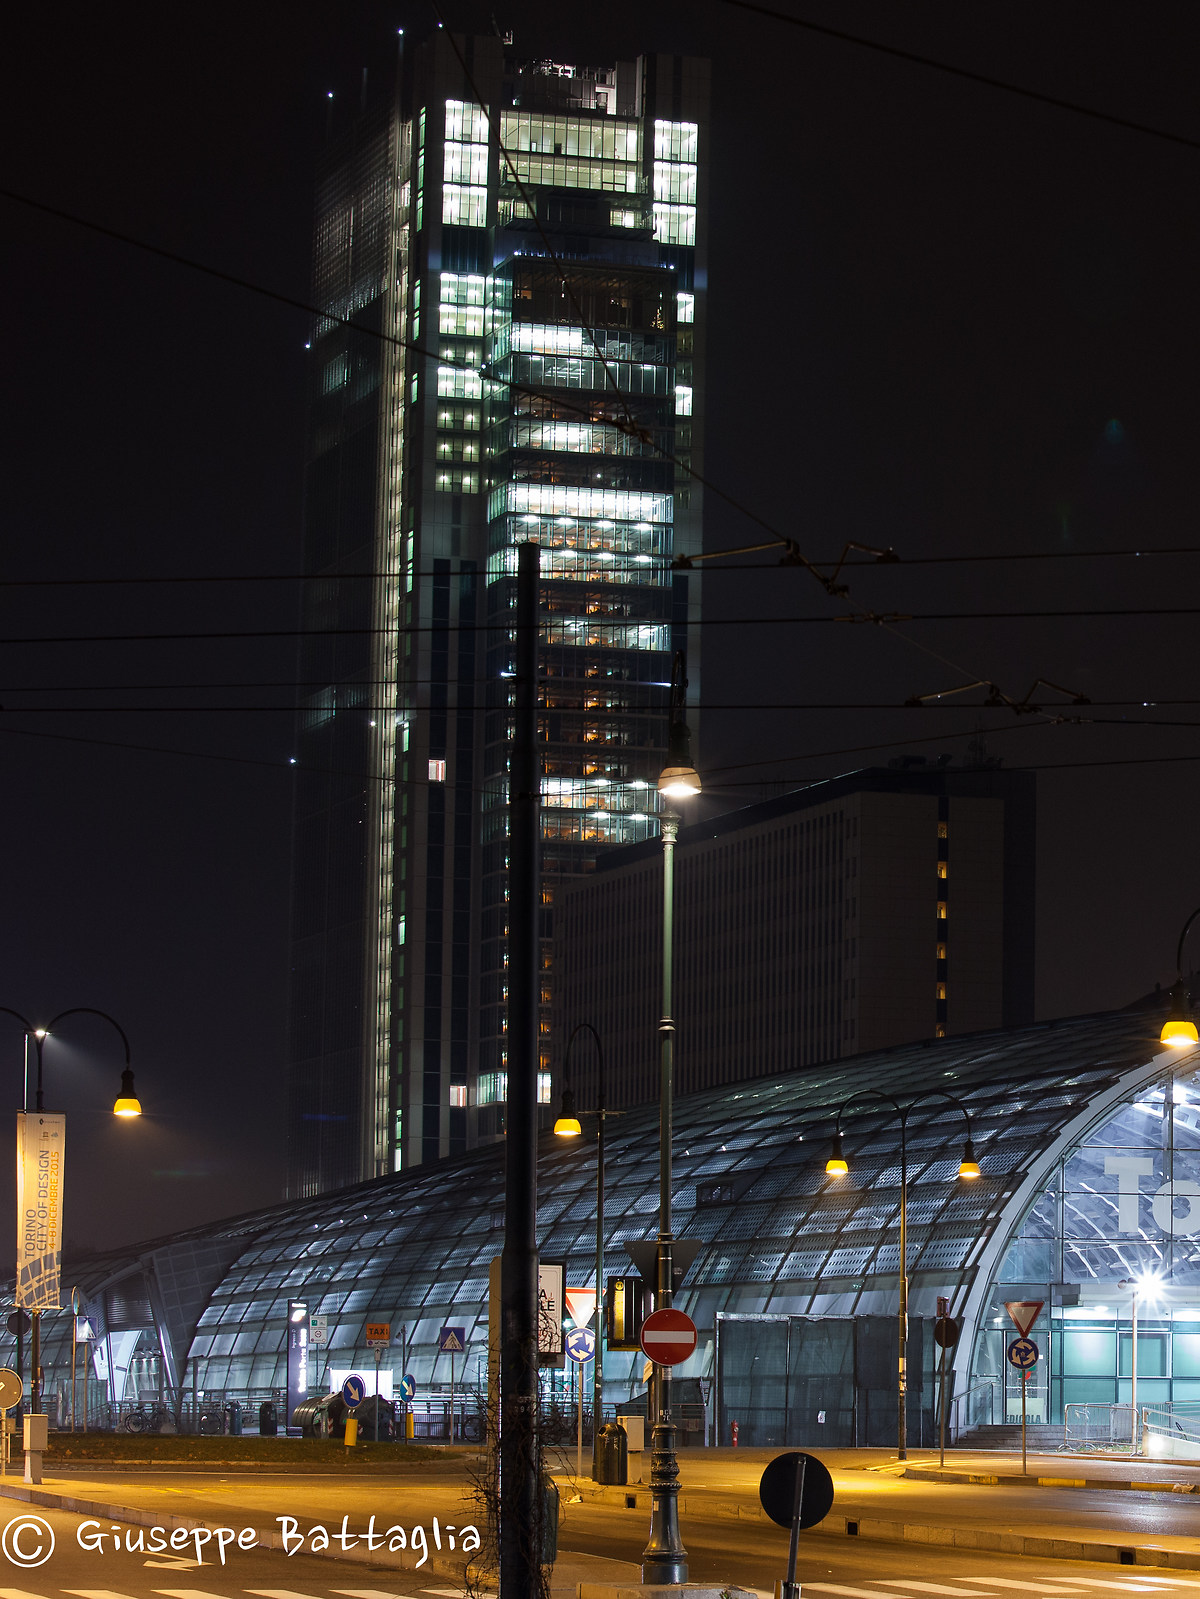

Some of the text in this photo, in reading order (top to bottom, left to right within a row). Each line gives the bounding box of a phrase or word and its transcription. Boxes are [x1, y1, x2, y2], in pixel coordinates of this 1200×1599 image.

[24, 1209, 36, 1259] TORINO
[36, 1150, 49, 1251] CITY OF DESIGN
[48, 1151, 59, 1249] 4-8 DICEMBRE 2015
[369, 1327, 388, 1335] TAXI
